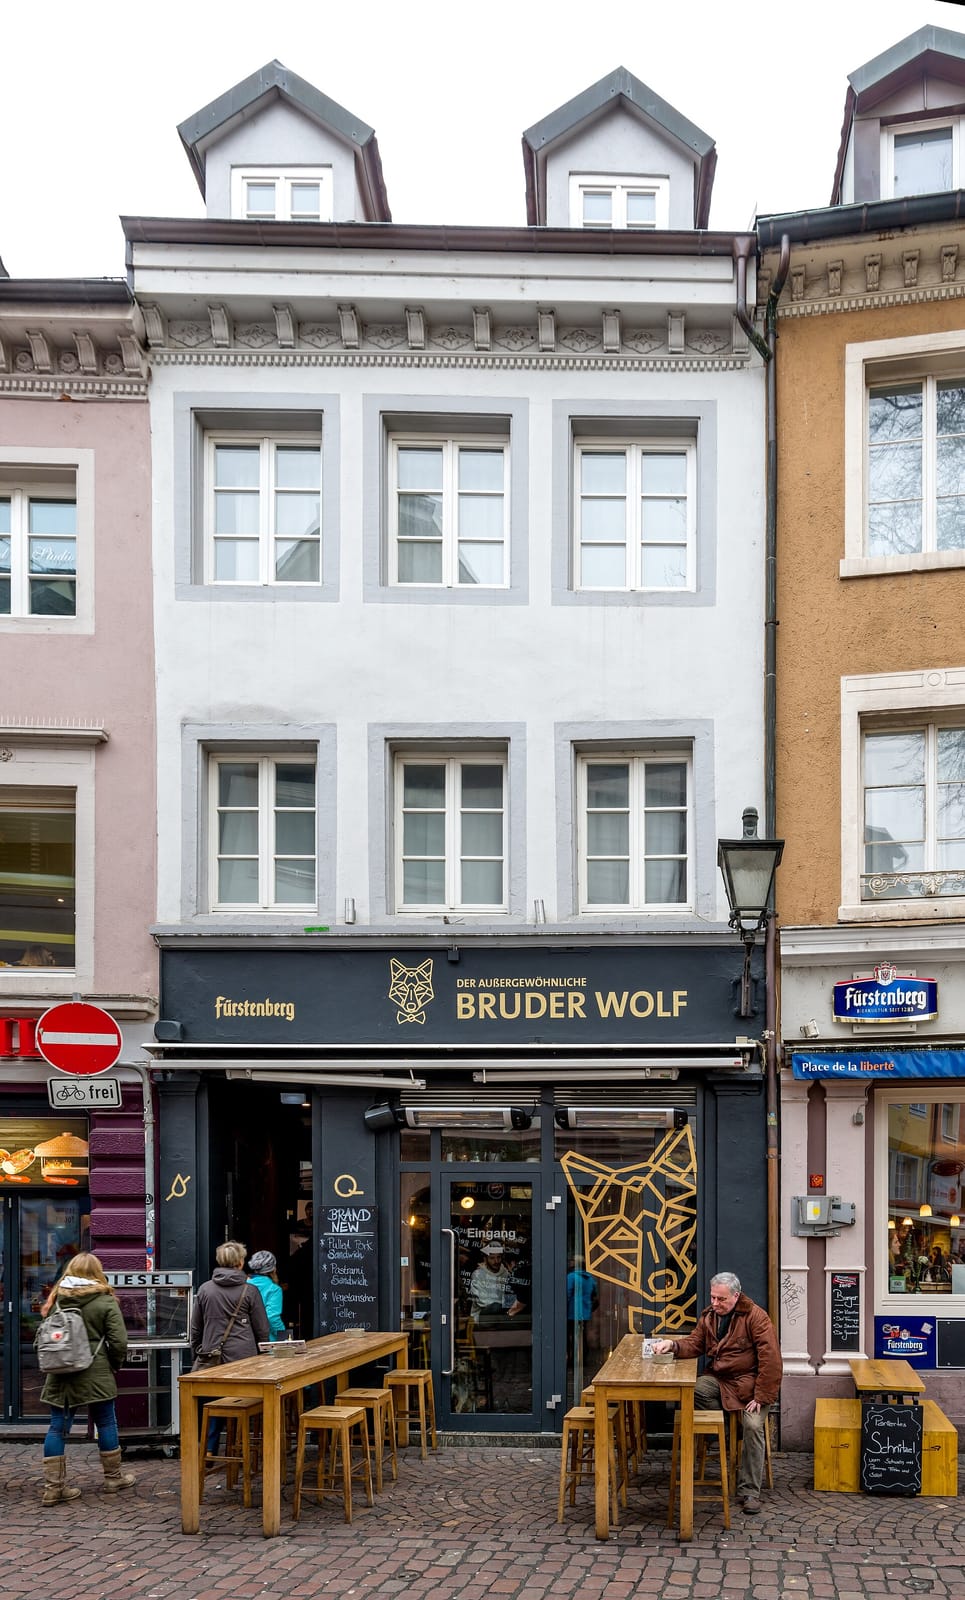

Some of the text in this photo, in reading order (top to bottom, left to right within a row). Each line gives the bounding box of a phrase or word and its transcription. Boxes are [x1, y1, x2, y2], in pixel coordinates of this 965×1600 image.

[456, 976, 587, 988] DER AUßERGEWÖHNLICHE
[456, 990, 688, 1020] BRUDER WOLF
[844, 987, 927, 1010] Fürstenberg
[214, 995, 296, 1022] Fürstenberg
[802, 1060, 896, 1072] Place de la liberté
[88, 1084, 115, 1100] frei
[327, 1207, 372, 1222] BRAND
[331, 1221, 360, 1233] NEW
[467, 1228, 516, 1241] Eingang
[354, 1239, 374, 1251] Pork
[330, 1263, 366, 1275] Pastrami
[833, 1288, 859, 1308] Burger
[333, 1306, 357, 1319] Teller
[887, 1339, 923, 1351] Fürstenberg
[866, 1431, 916, 1454] Schnitzel
